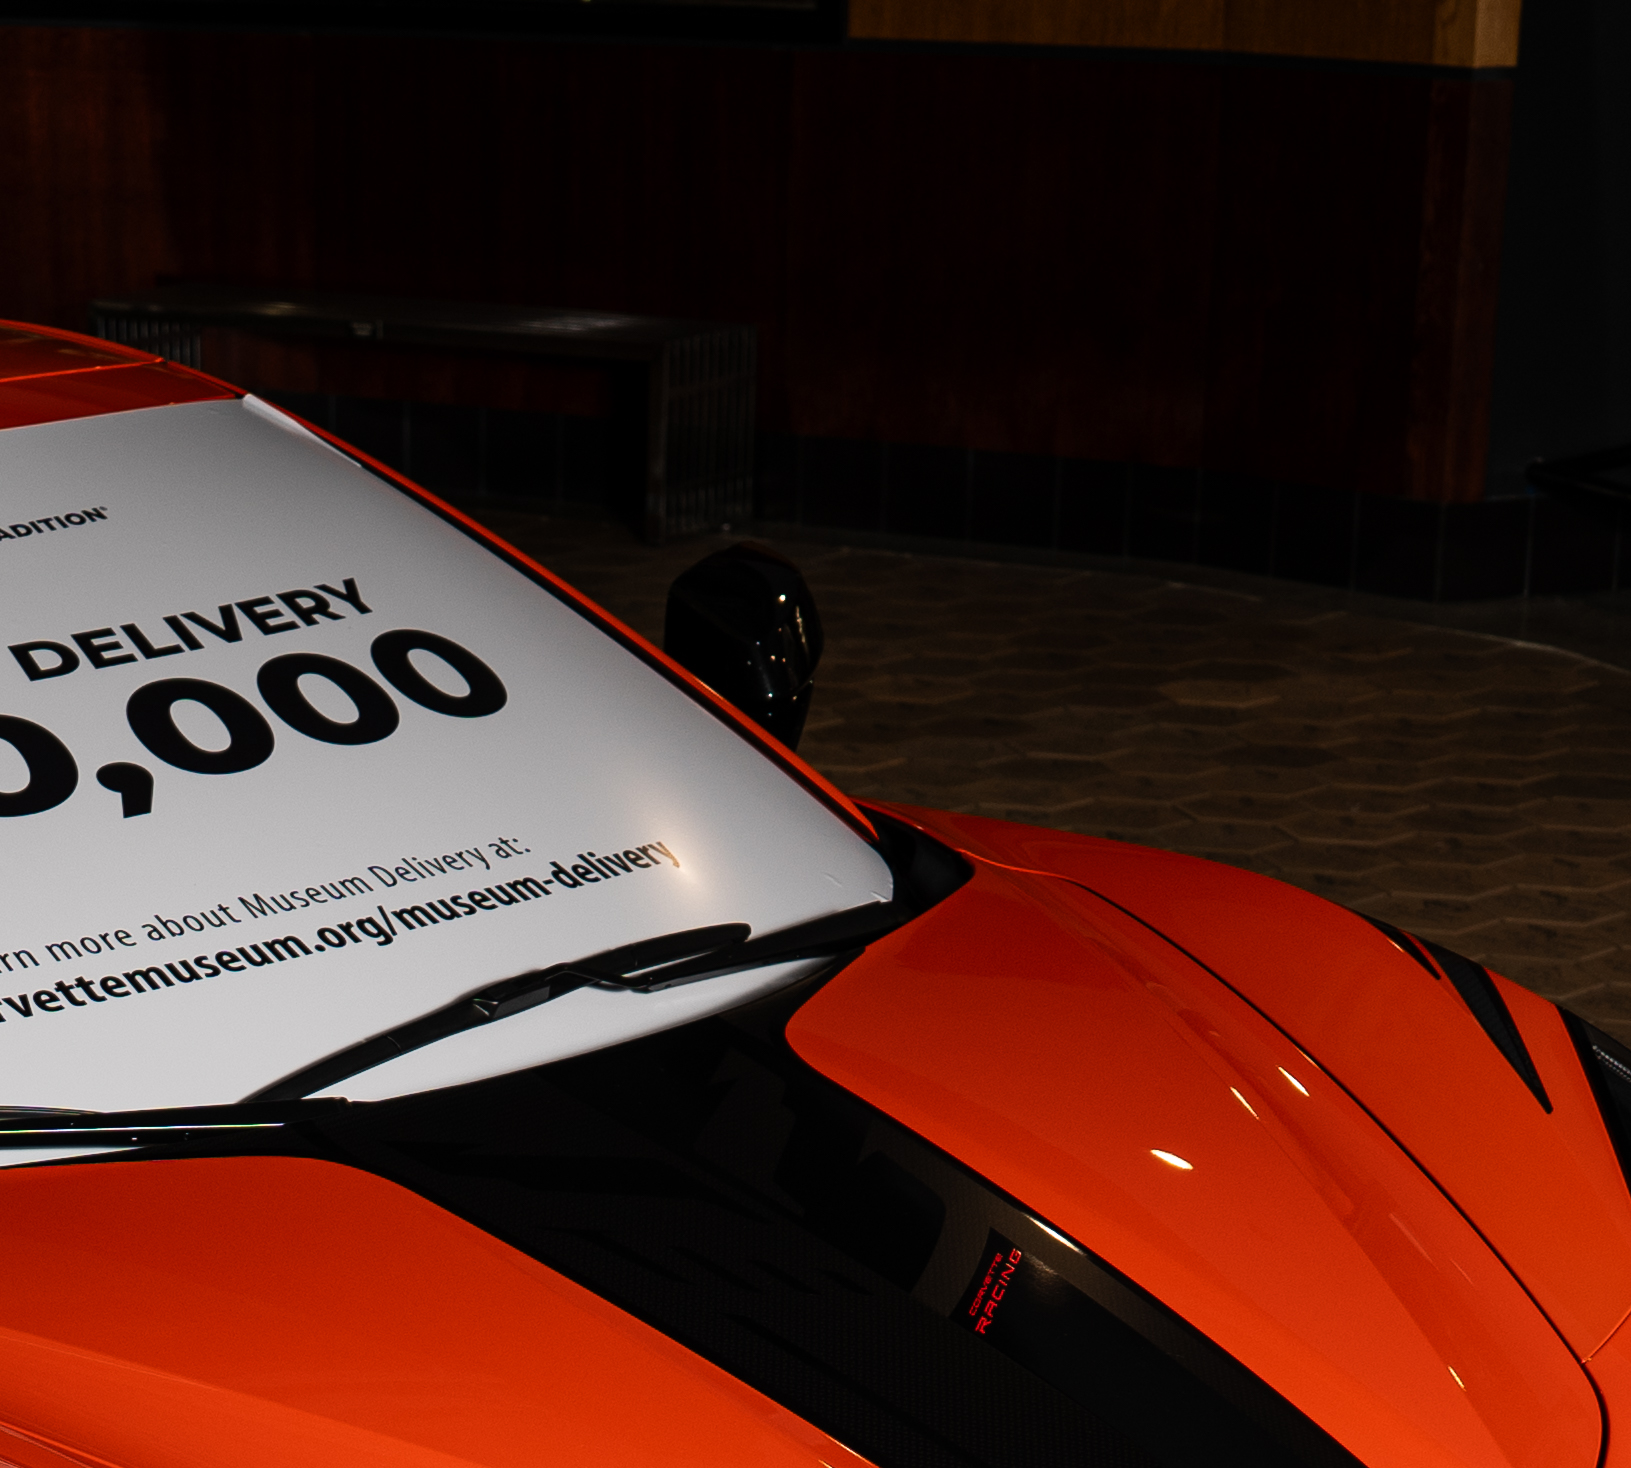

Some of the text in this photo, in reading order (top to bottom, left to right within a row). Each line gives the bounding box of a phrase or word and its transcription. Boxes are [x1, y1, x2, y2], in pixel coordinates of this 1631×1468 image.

[8, 577, 371, 683] DELIVERY
[48, 921, 137, 961] more
[143, 899, 239, 945] about
[241, 874, 368, 921] Museum
[368, 844, 489, 898] Delivery
[487, 832, 531, 867] at:
[975, 1248, 1022, 1334] RACING
